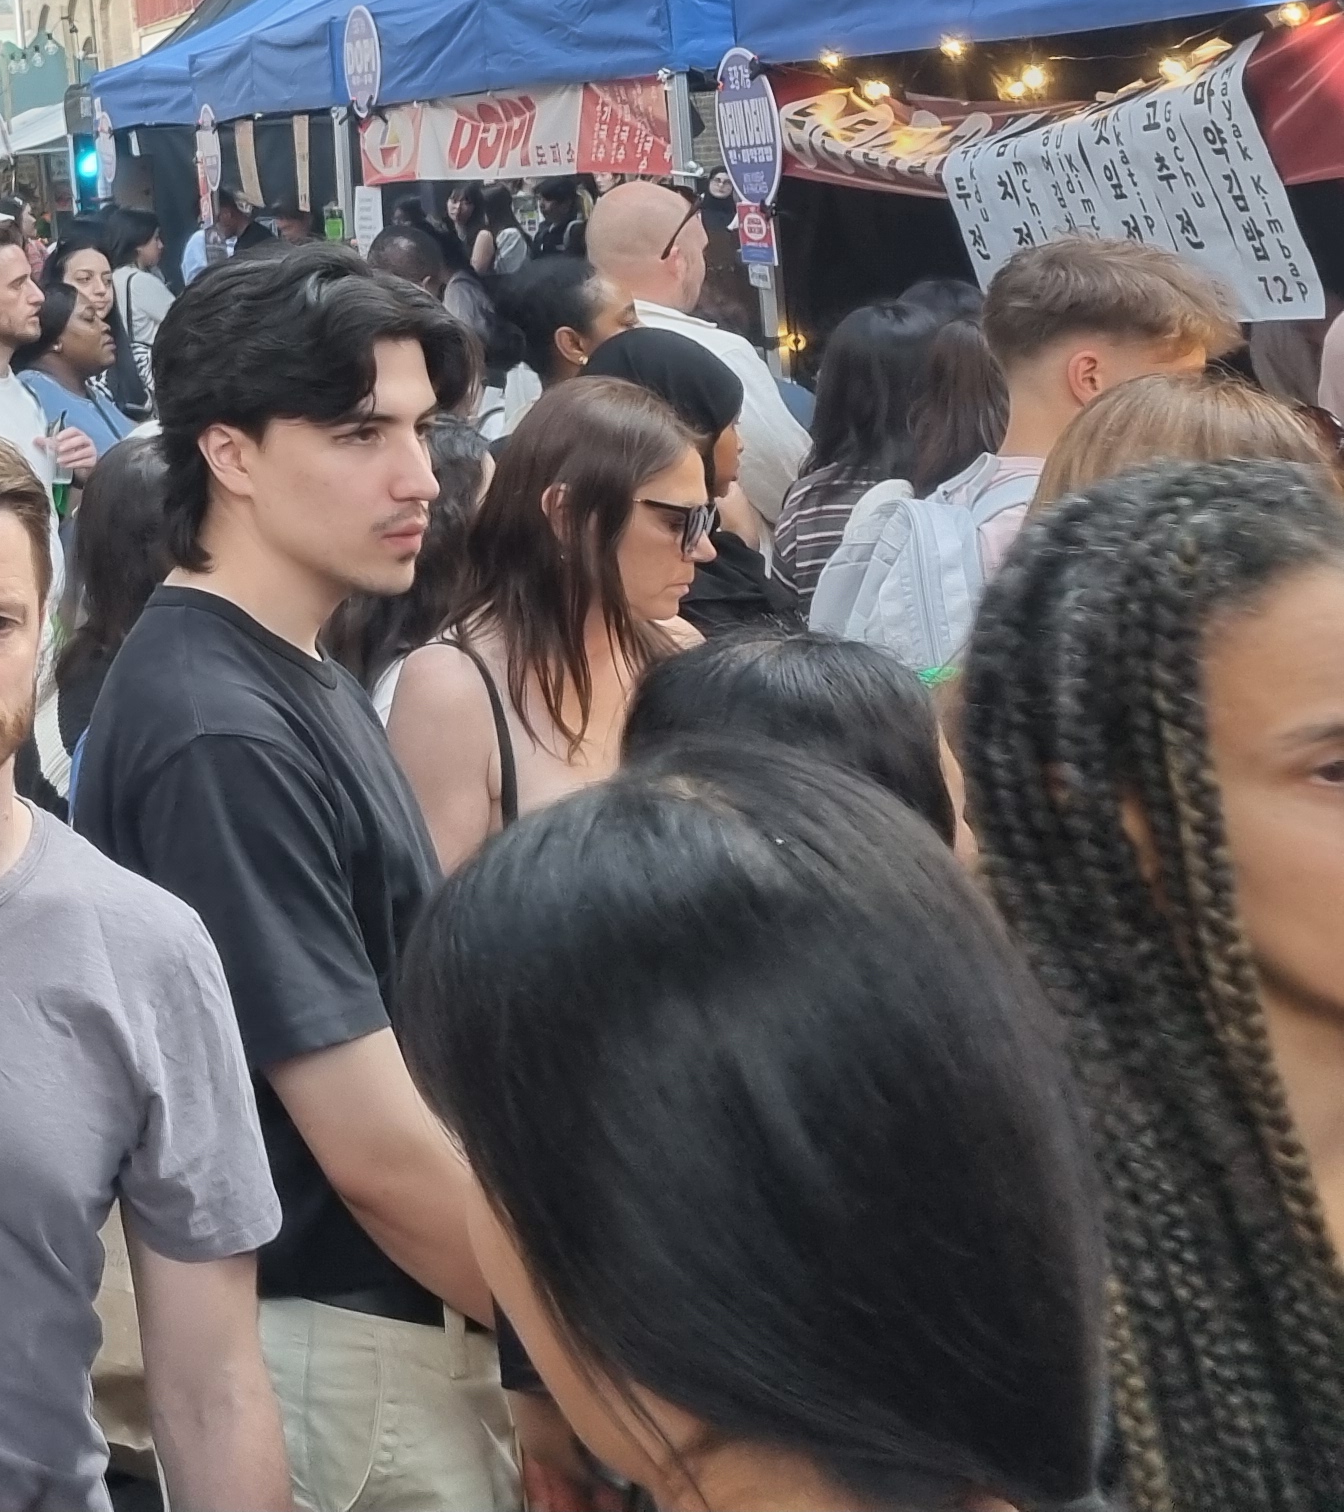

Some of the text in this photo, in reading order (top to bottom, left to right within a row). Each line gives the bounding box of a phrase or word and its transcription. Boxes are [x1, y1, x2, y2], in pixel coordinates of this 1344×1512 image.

[346, 38, 375, 75] DOPI
[448, 95, 537, 170] DOPI
[719, 100, 747, 148] DEUN
[743, 97, 773, 146] DEUN
